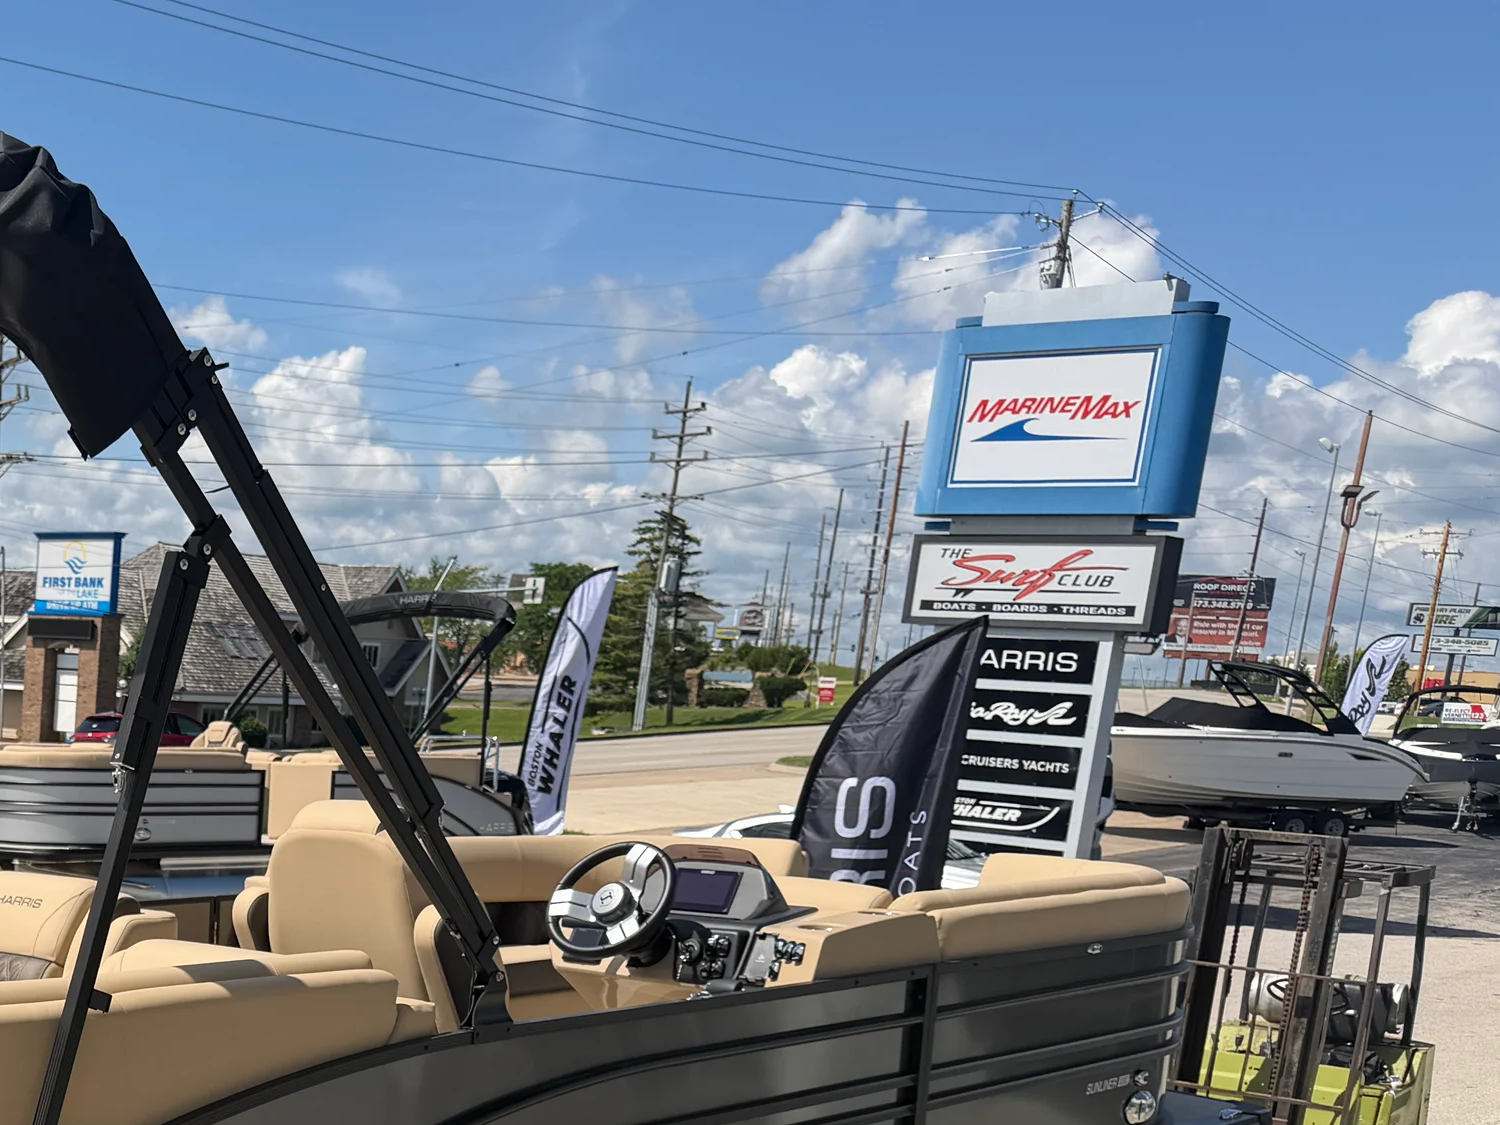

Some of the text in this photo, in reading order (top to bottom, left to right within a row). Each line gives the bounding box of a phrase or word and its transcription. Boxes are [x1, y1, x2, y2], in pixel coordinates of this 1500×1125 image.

[940, 548, 973, 559] THE
[42, 576, 105, 589] FIRST BANK
[941, 549, 1130, 601] Surf
[1057, 573, 1115, 587] CLUB
[76, 589, 100, 599] LAKE
[1193, 583, 1219, 591] ROOF
[932, 602, 1127, 616] BOATS BOARDS THREADS
[1433, 614, 1459, 625] IRE
[980, 649, 1079, 672] ARRIS
[537, 675, 577, 795] WHALER
[528, 741, 543, 787] BOSTON
[961, 754, 1070, 774] CRUISERS YACHTS
[953, 804, 1022, 822] HALER
[898, 810, 927, 897] OATS
